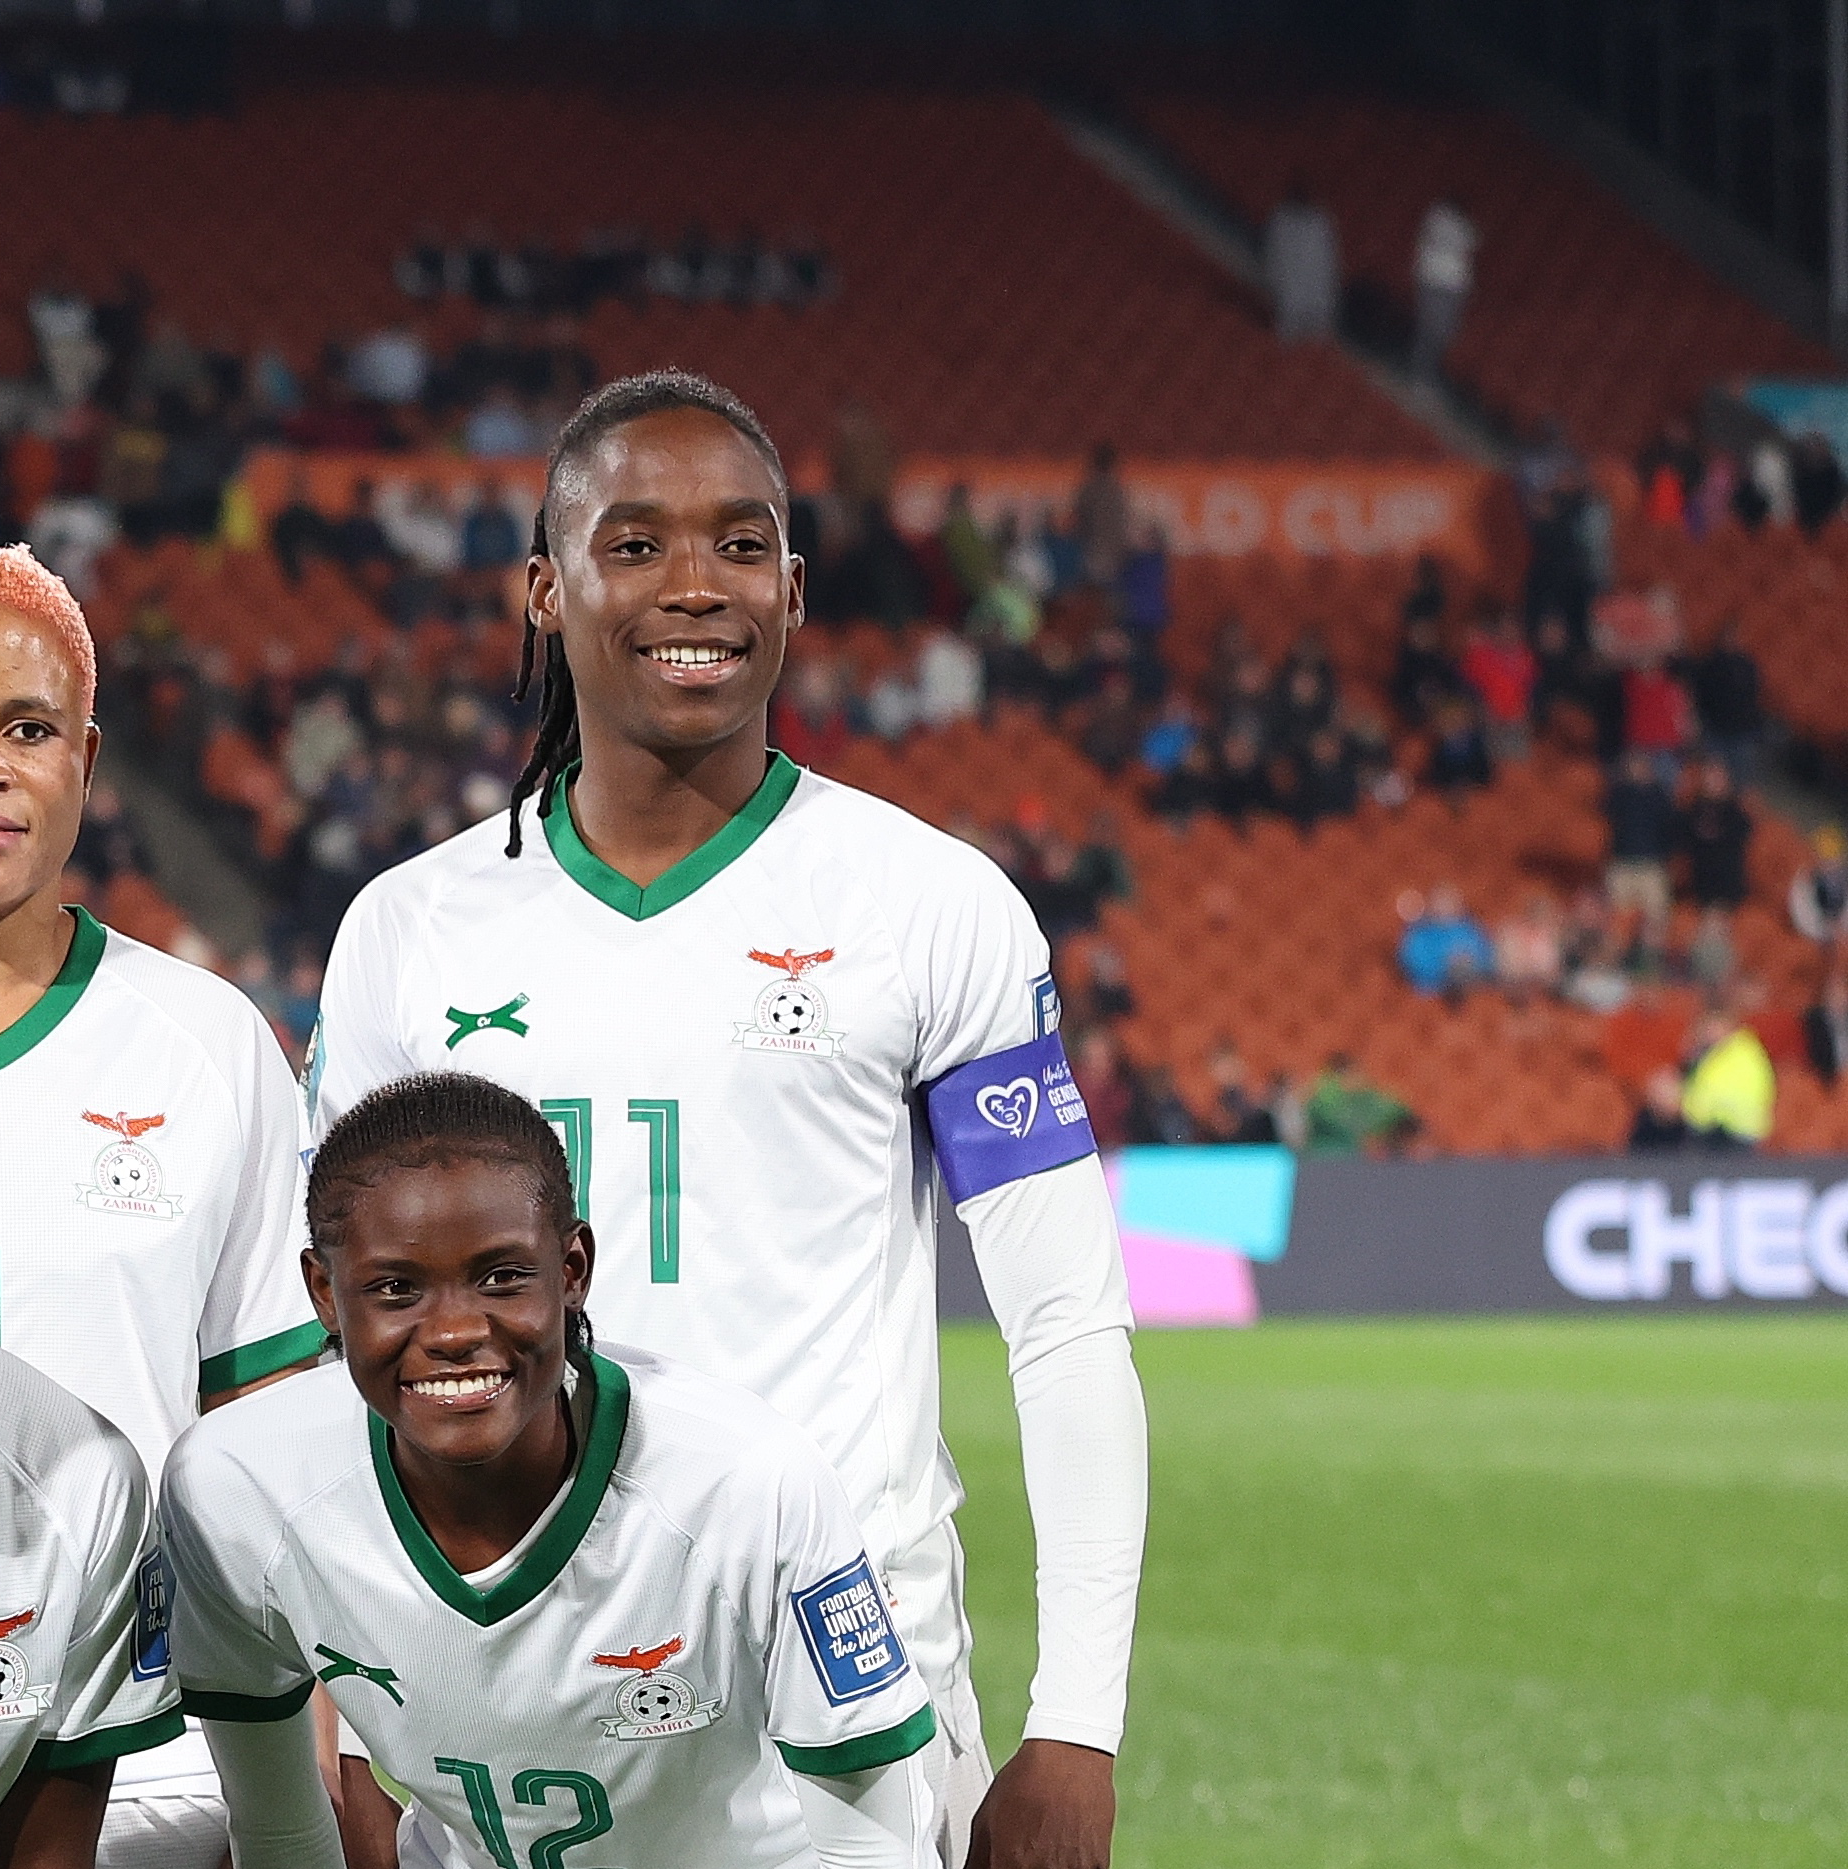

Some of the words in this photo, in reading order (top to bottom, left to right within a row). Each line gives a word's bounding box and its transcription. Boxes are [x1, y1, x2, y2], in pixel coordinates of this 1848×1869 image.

[759, 1036, 816, 1052] ZAMBIA
[540, 1098, 681, 1285] 11
[102, 1198, 157, 1215] ZAMBIA
[818, 1578, 873, 1617] FOOTBALL
[824, 1595, 881, 1638] UNITES
[829, 1639, 858, 1659] the
[861, 1651, 886, 1669] FIFA
[633, 1719, 694, 1736] ZAMBIA
